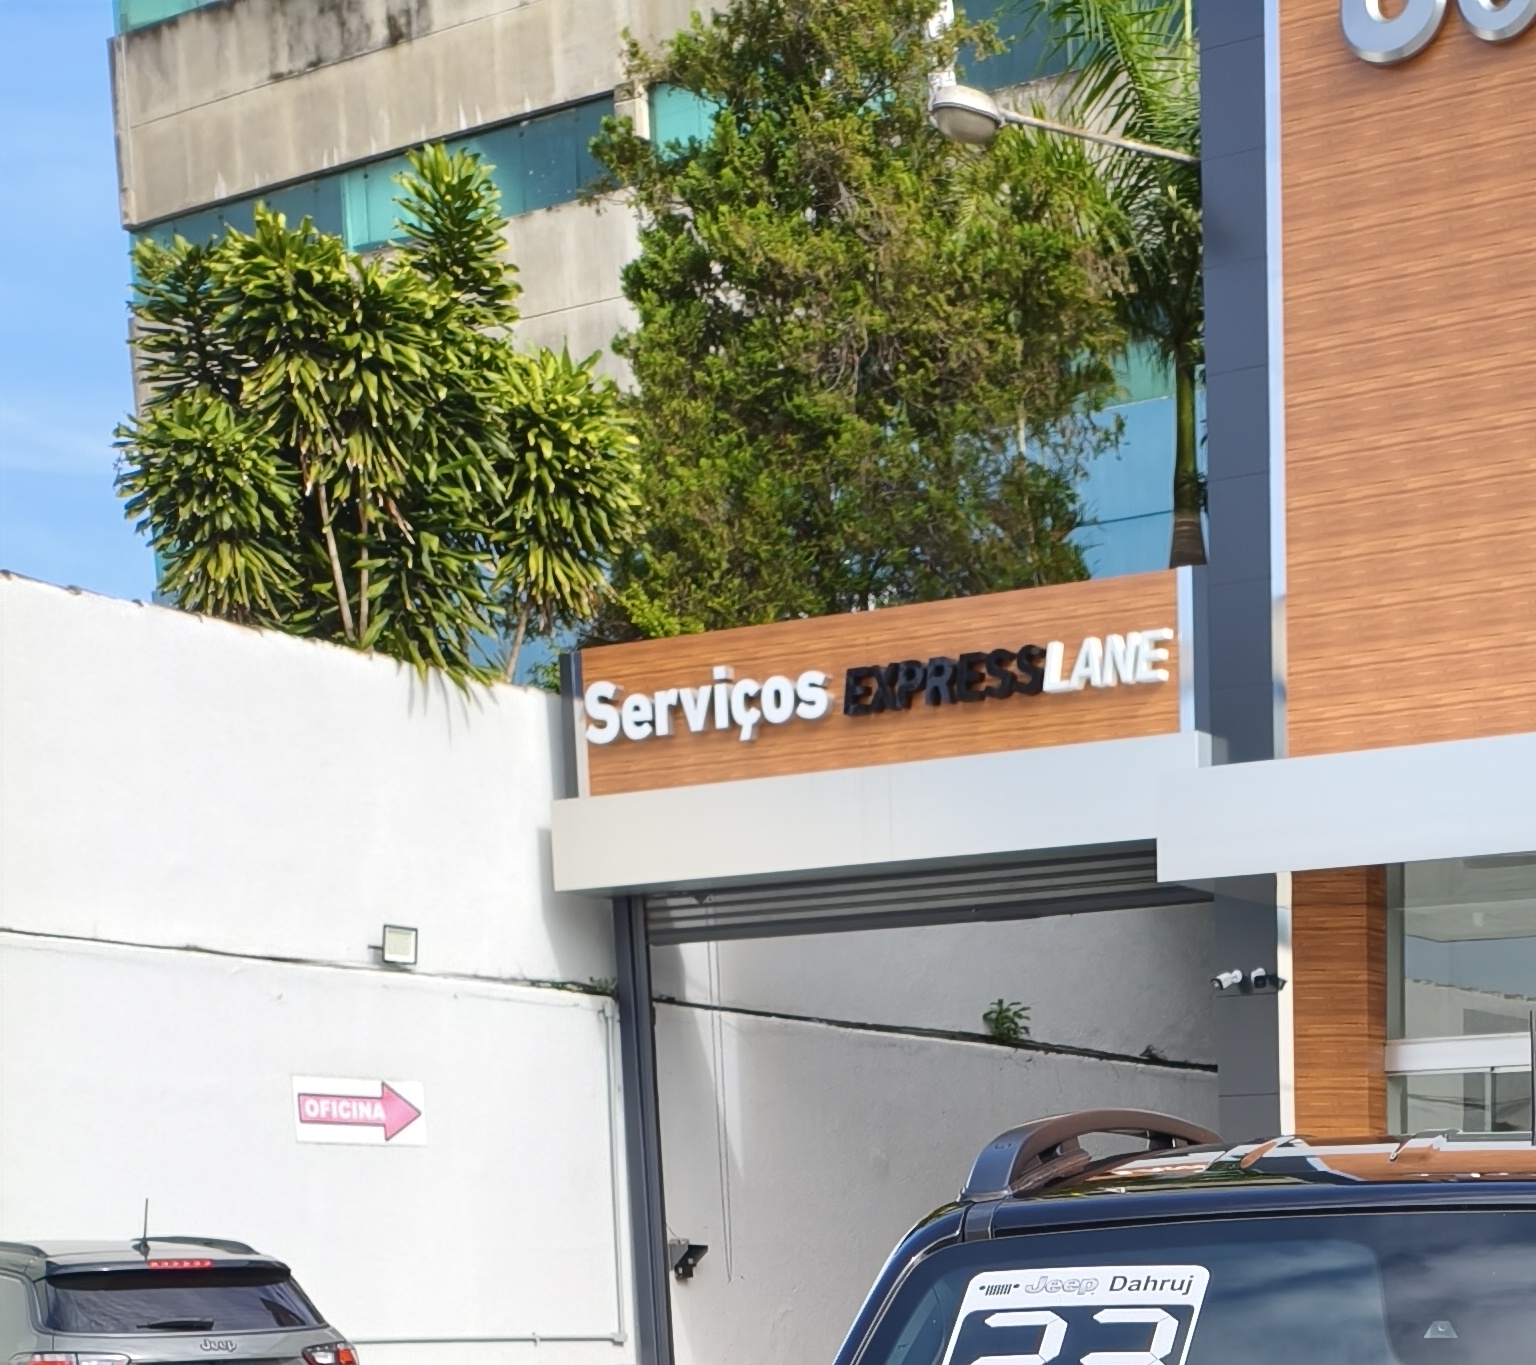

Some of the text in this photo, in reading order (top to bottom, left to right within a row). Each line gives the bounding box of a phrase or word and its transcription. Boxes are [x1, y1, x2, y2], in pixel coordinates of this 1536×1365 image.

[584, 666, 835, 743] Serviços
[304, 1098, 386, 1121] OFICINA
[1024, 1274, 1195, 1296] Jeep Dahruj
[199, 1339, 238, 1353] Jeep
